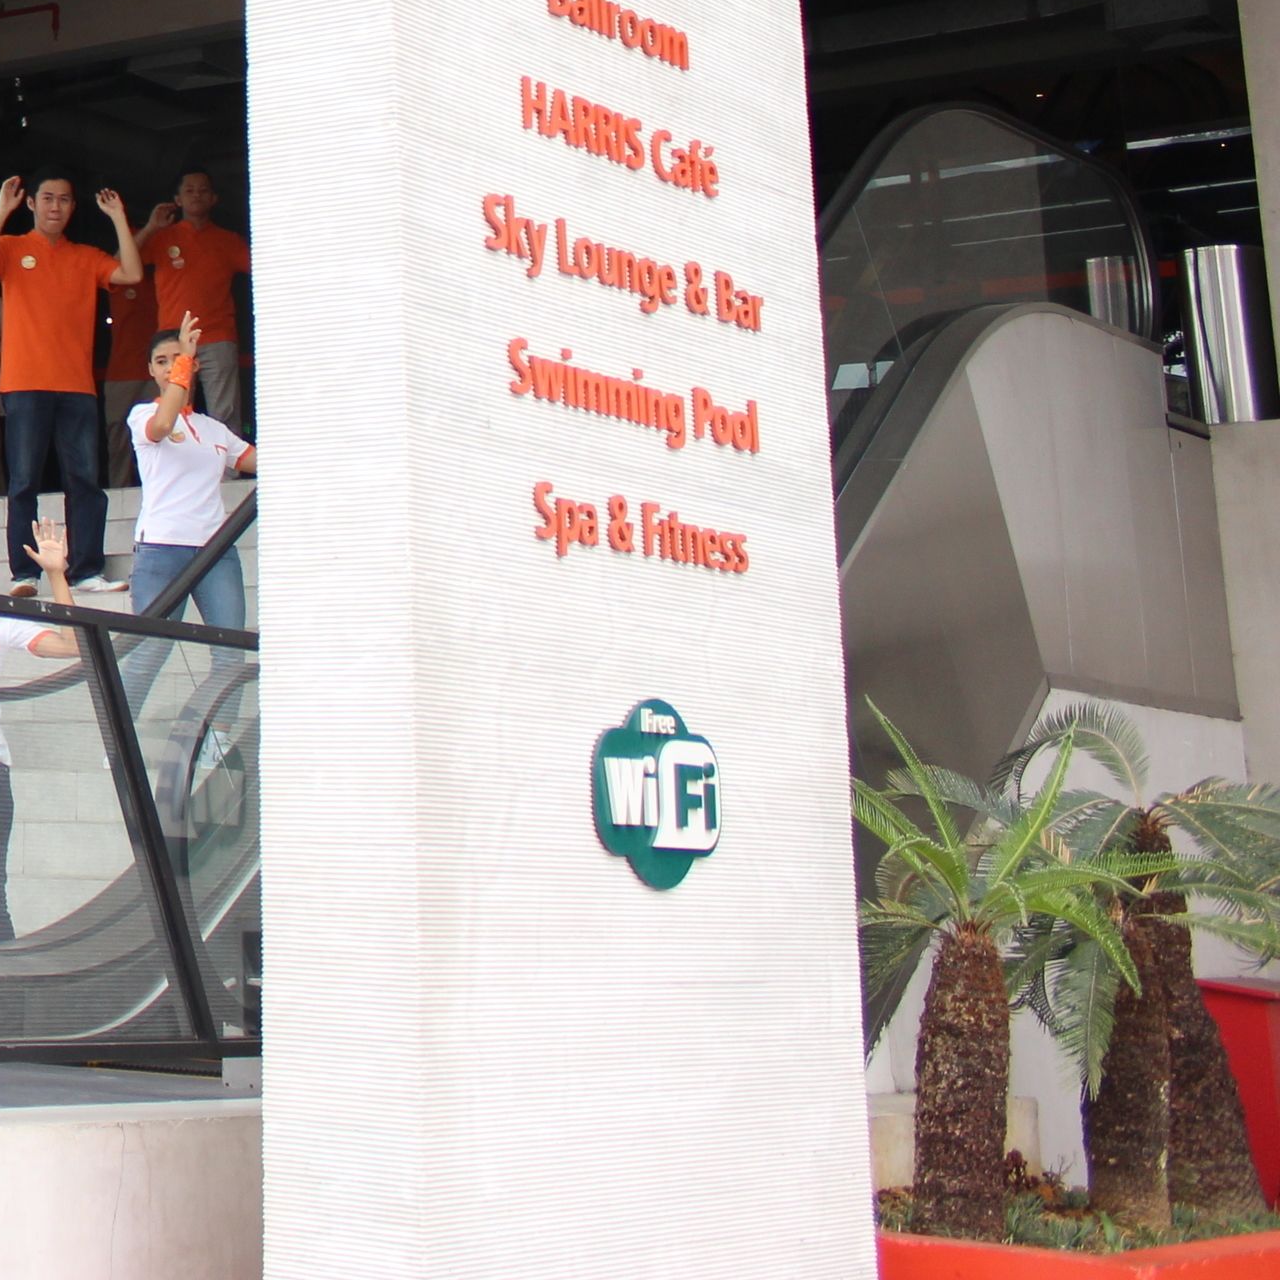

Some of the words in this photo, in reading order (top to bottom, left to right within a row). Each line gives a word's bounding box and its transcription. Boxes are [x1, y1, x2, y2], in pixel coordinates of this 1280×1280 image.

[521, 76, 645, 169] HARRIS
[651, 130, 719, 198] Café
[482, 193, 547, 278] Sky
[555, 218, 677, 314] Lounge
[684, 261, 710, 316] &
[714, 270, 764, 332] Bar
[507, 337, 686, 450] Swimming
[691, 387, 760, 454] Pool
[533, 481, 599, 558] Spa
[607, 495, 634, 553] &
[640, 502, 749, 574] Fitness
[640, 708, 676, 734] Free
